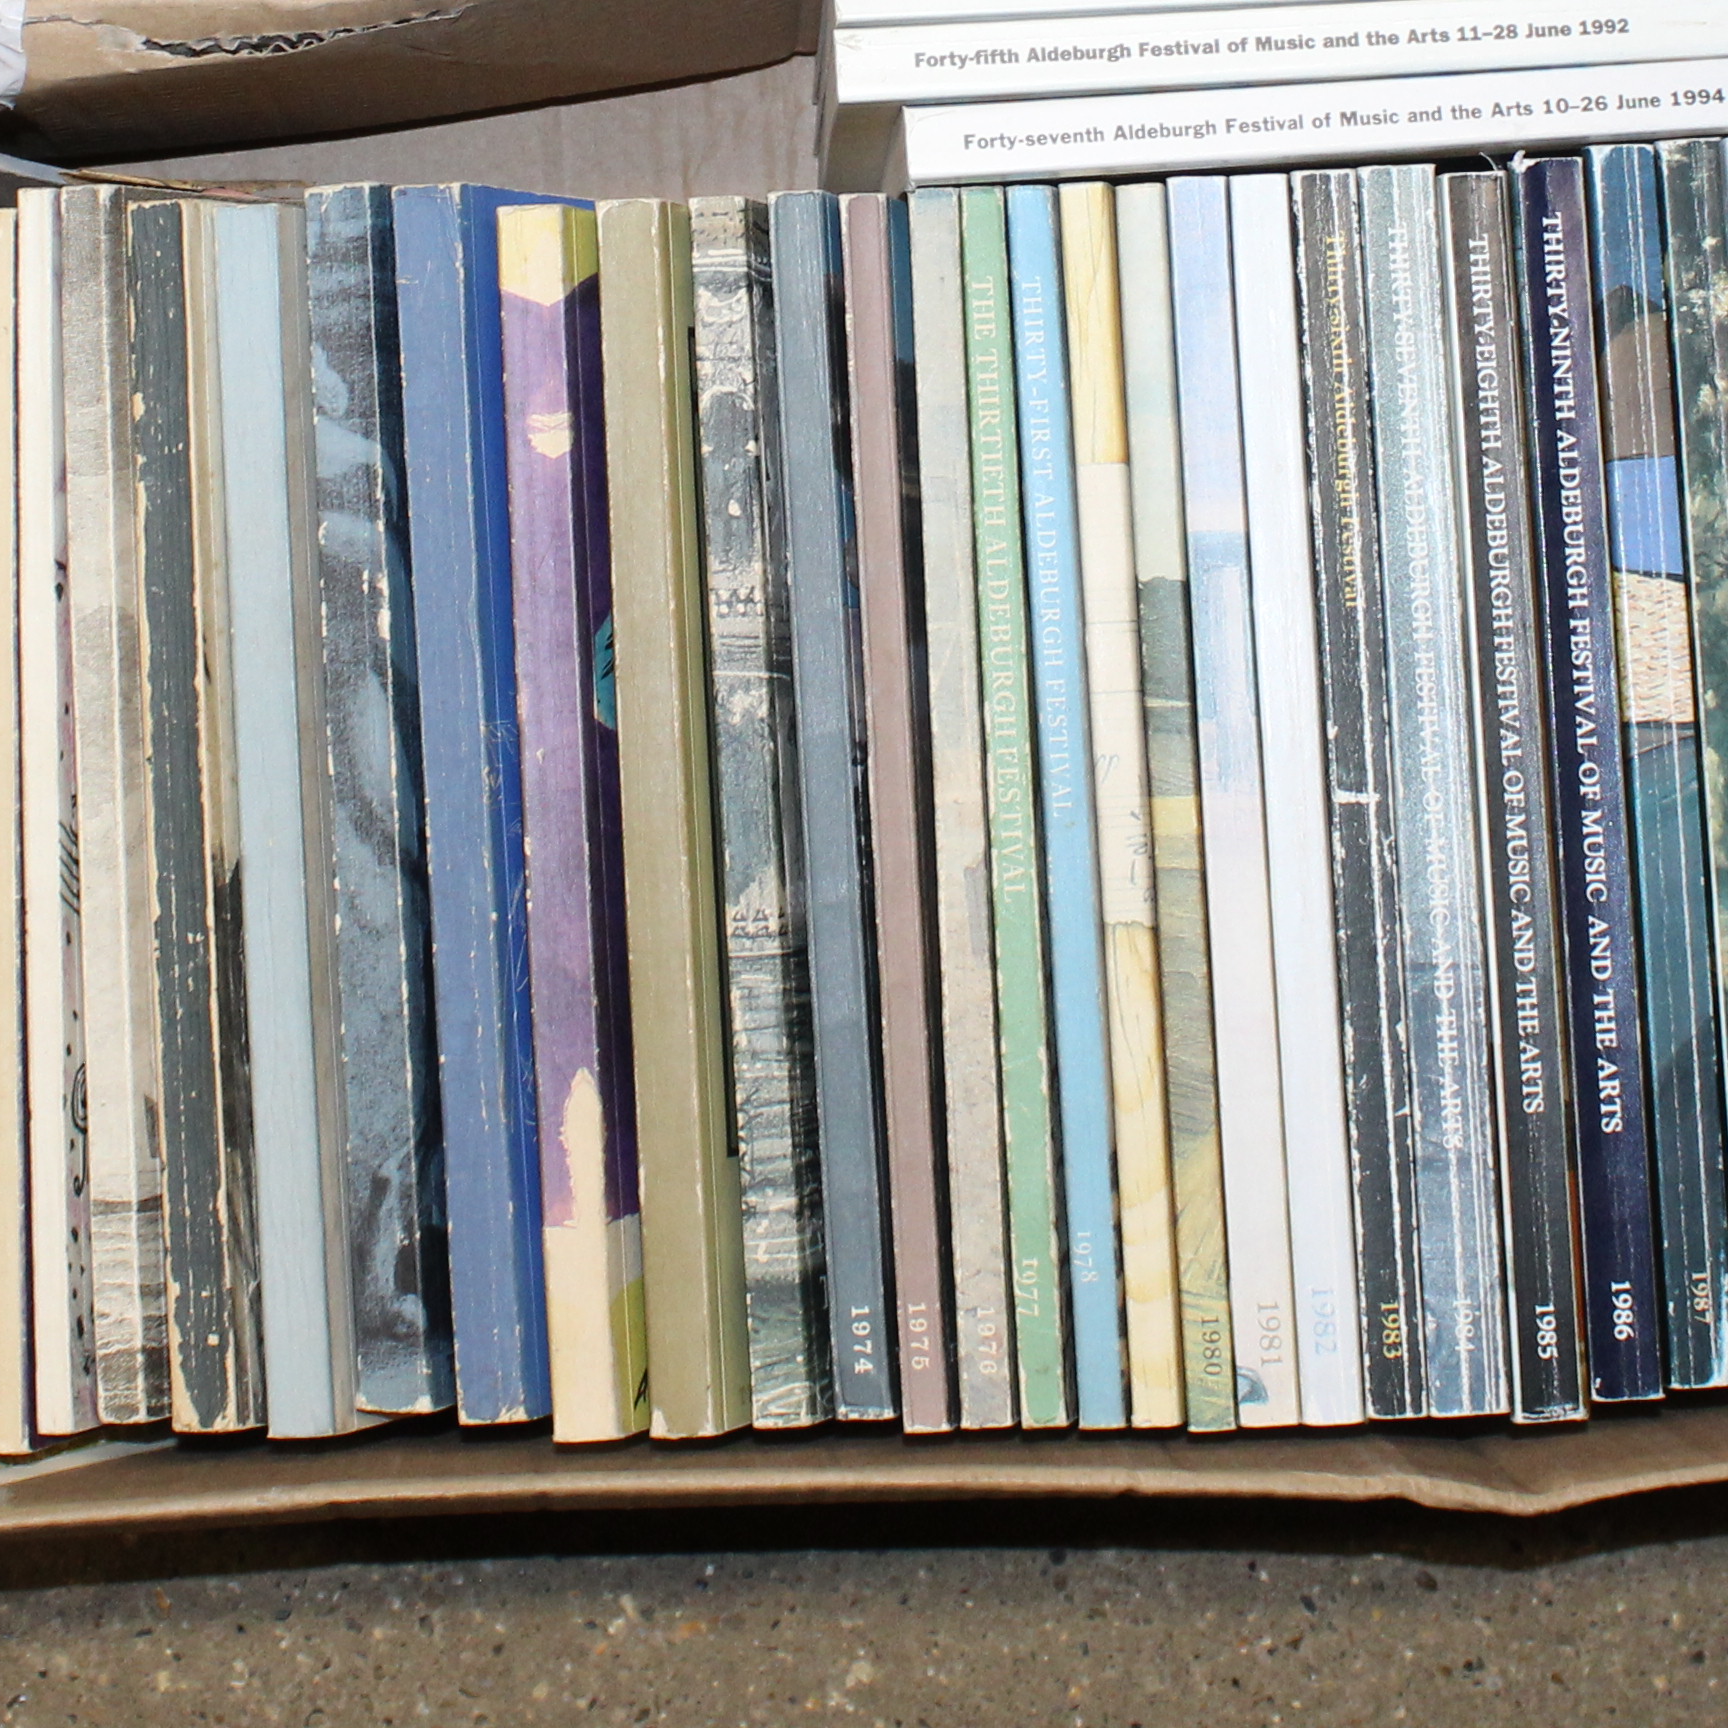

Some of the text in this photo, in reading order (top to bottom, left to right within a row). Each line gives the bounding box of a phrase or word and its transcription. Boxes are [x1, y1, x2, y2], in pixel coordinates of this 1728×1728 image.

[1333, 380, 1361, 508] Aldeburgh
[1339, 515, 1365, 608] Festival
[970, 276, 1039, 1318] THE THIRTIETH ALDEBURGH FESTIVAL 1977
[1021, 276, 1098, 1283] THIRTY-FIRST ALDEBURGH FESTIVAL 1978
[1542, 211, 1634, 1341] THIRTY-NINTH ALDEBURGH FESTIVAL OF MUSIC AND THE ARTS 1986
[1311, 1286, 1338, 1355] 1982
[1380, 1300, 1402, 1359] 1983
[1534, 1303, 1557, 1360] 1985
[1691, 1271, 1713, 1323] 1987
[850, 1304, 873, 1374] 1974
[907, 1302, 931, 1371] 1975
[976, 1305, 998, 1374] 1976
[1200, 1315, 1223, 1377] 1980
[1257, 1301, 1283, 1368] 1981
